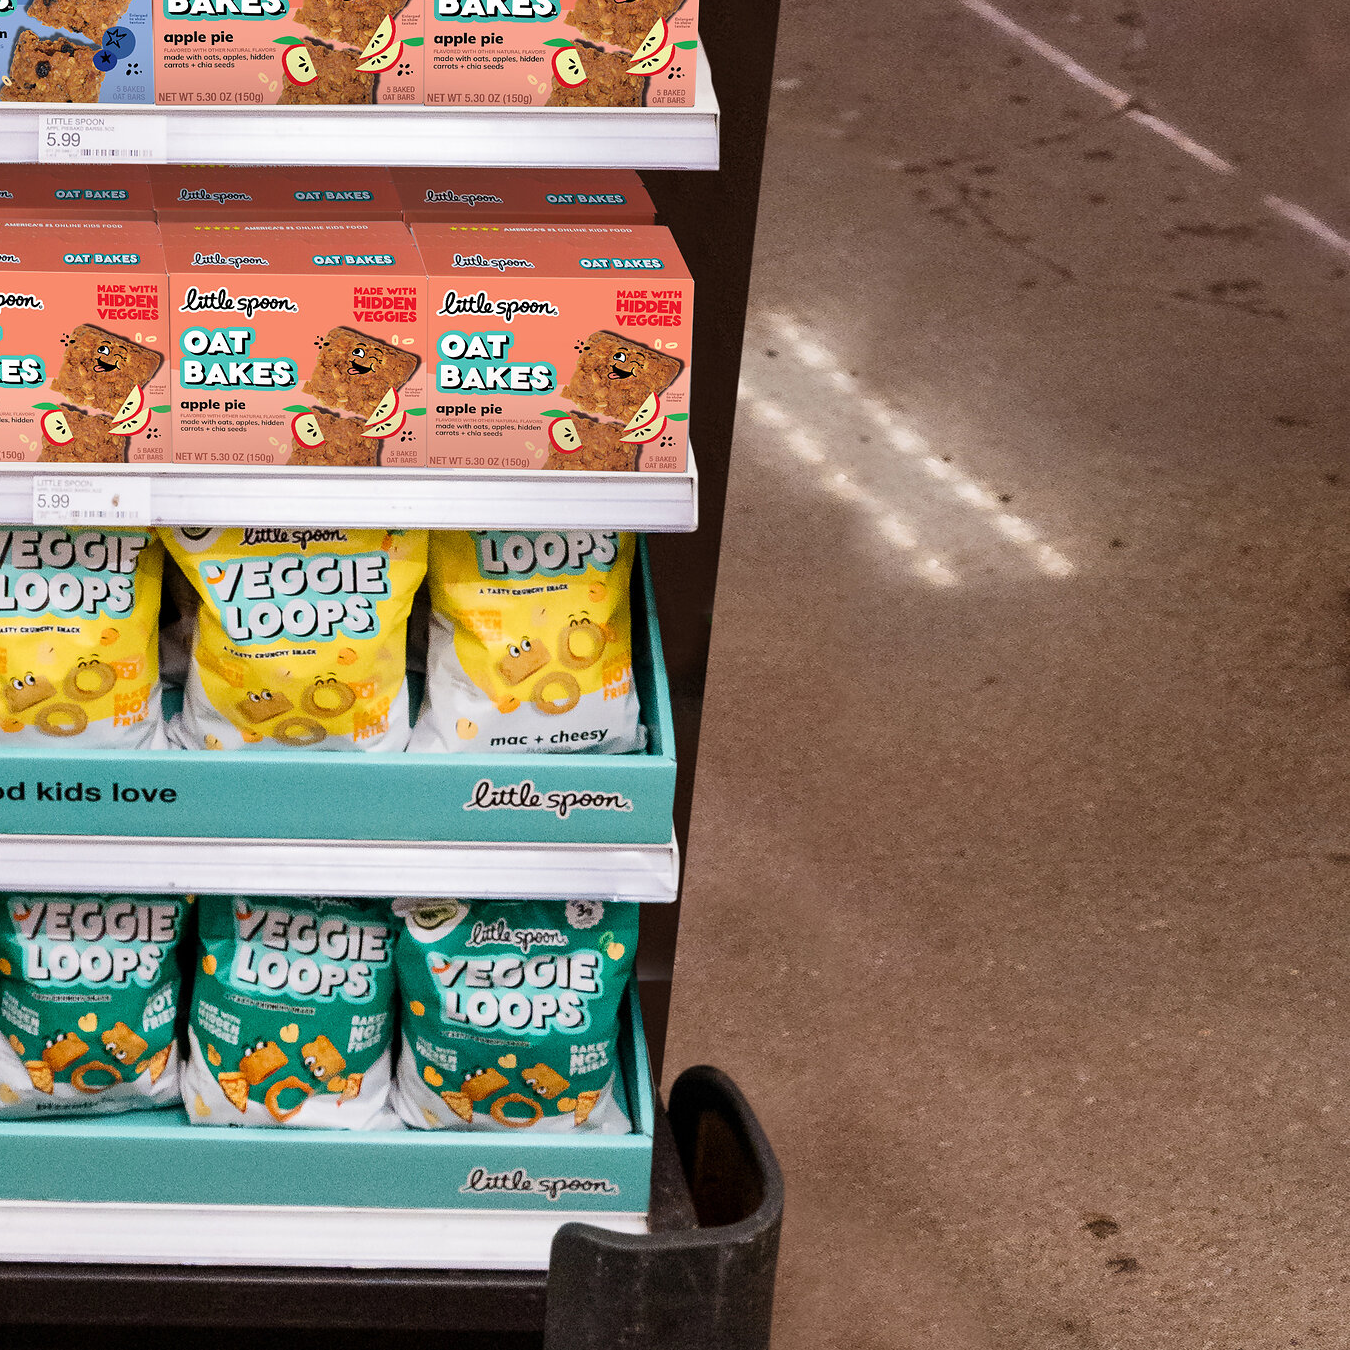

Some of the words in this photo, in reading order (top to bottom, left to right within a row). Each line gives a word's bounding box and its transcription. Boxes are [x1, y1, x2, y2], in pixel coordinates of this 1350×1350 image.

[434, 33, 474, 47] apple
[478, 33, 504, 47] pie
[46, 132, 81, 147] 5.99
[37, 493, 70, 509] 5.99
[204, 557, 387, 599] VEGGIE
[227, 599, 372, 640] LOOPS
[490, 734, 528, 746] mac
[533, 734, 543, 746] +
[549, 726, 608, 748] cheesy
[36, 782, 100, 802] kids
[113, 783, 177, 803] love
[468, 782, 542, 808] little
[433, 954, 597, 991] VEGGIE
[446, 991, 584, 1027] LOOPS
[466, 1167, 532, 1194] little
